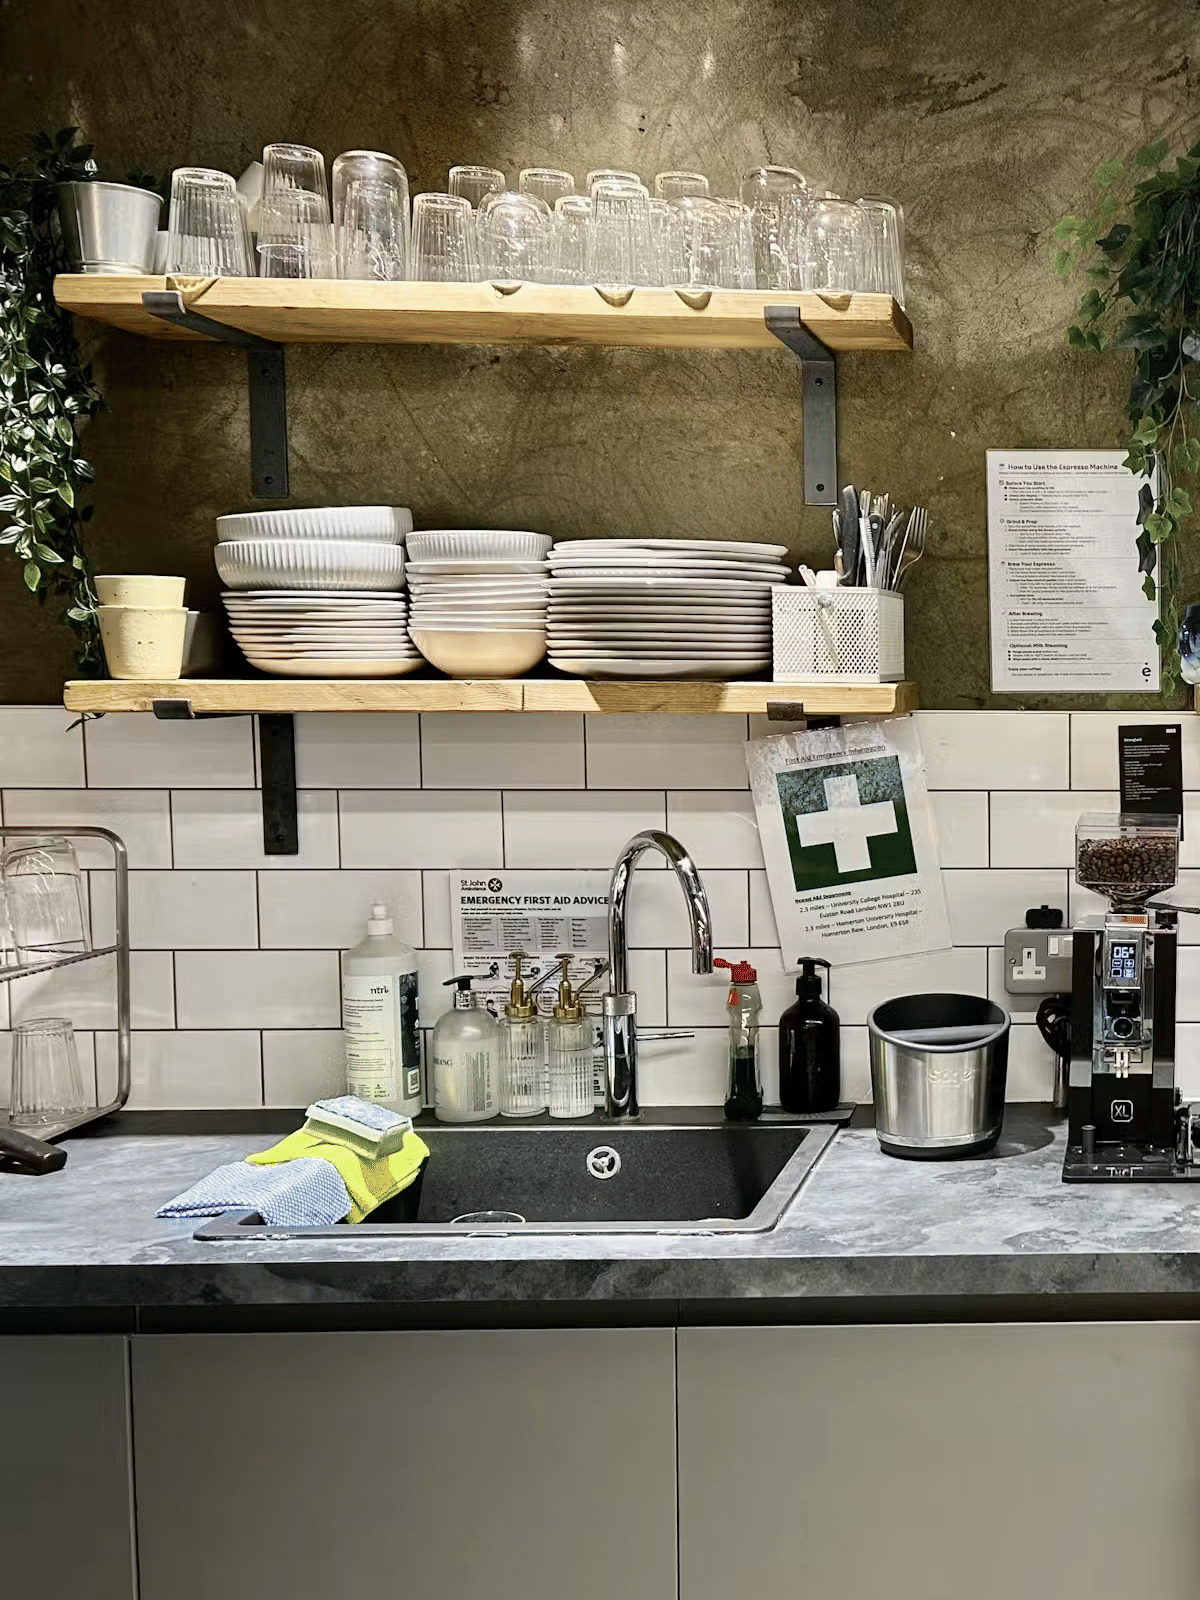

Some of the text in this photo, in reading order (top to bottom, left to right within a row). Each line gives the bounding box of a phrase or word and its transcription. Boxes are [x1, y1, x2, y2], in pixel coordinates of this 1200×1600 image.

[830, 899, 859, 908] University
[860, 895, 881, 903] College
[882, 891, 904, 900] Hospital
[856, 905, 876, 913] London
[836, 918, 864, 927] Homerton
[866, 913, 894, 922] University
[895, 910, 917, 918] Hospital
[822, 929, 850, 938] Homerton
[867, 923, 889, 931] London,
[1114, 1104, 1129, 1116] XL
